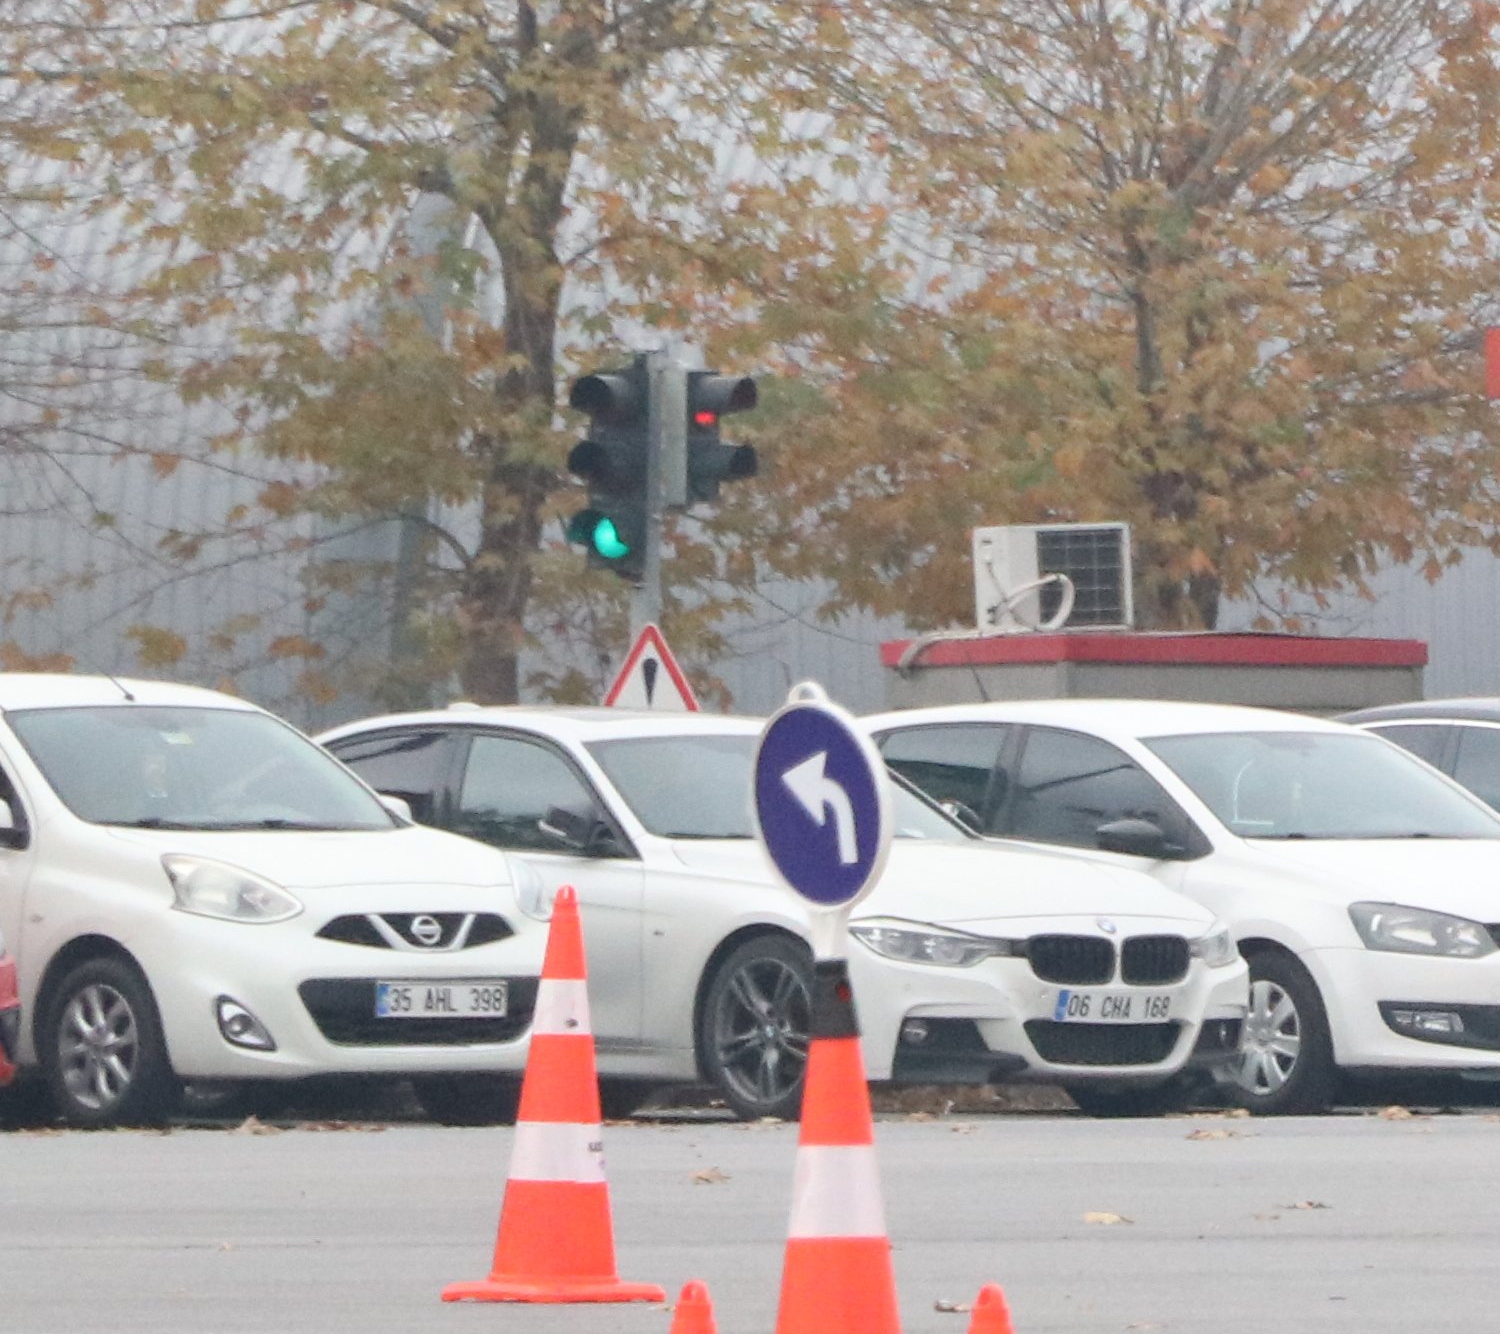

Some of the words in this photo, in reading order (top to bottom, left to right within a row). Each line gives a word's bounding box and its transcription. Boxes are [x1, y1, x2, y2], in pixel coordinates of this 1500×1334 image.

[390, 988, 412, 1012] 35
[425, 987, 457, 1012] AHL
[469, 987, 502, 1012] 398
[1067, 994, 1091, 1017] 06
[1101, 995, 1132, 1018] CHA
[1144, 995, 1171, 1018] 168
